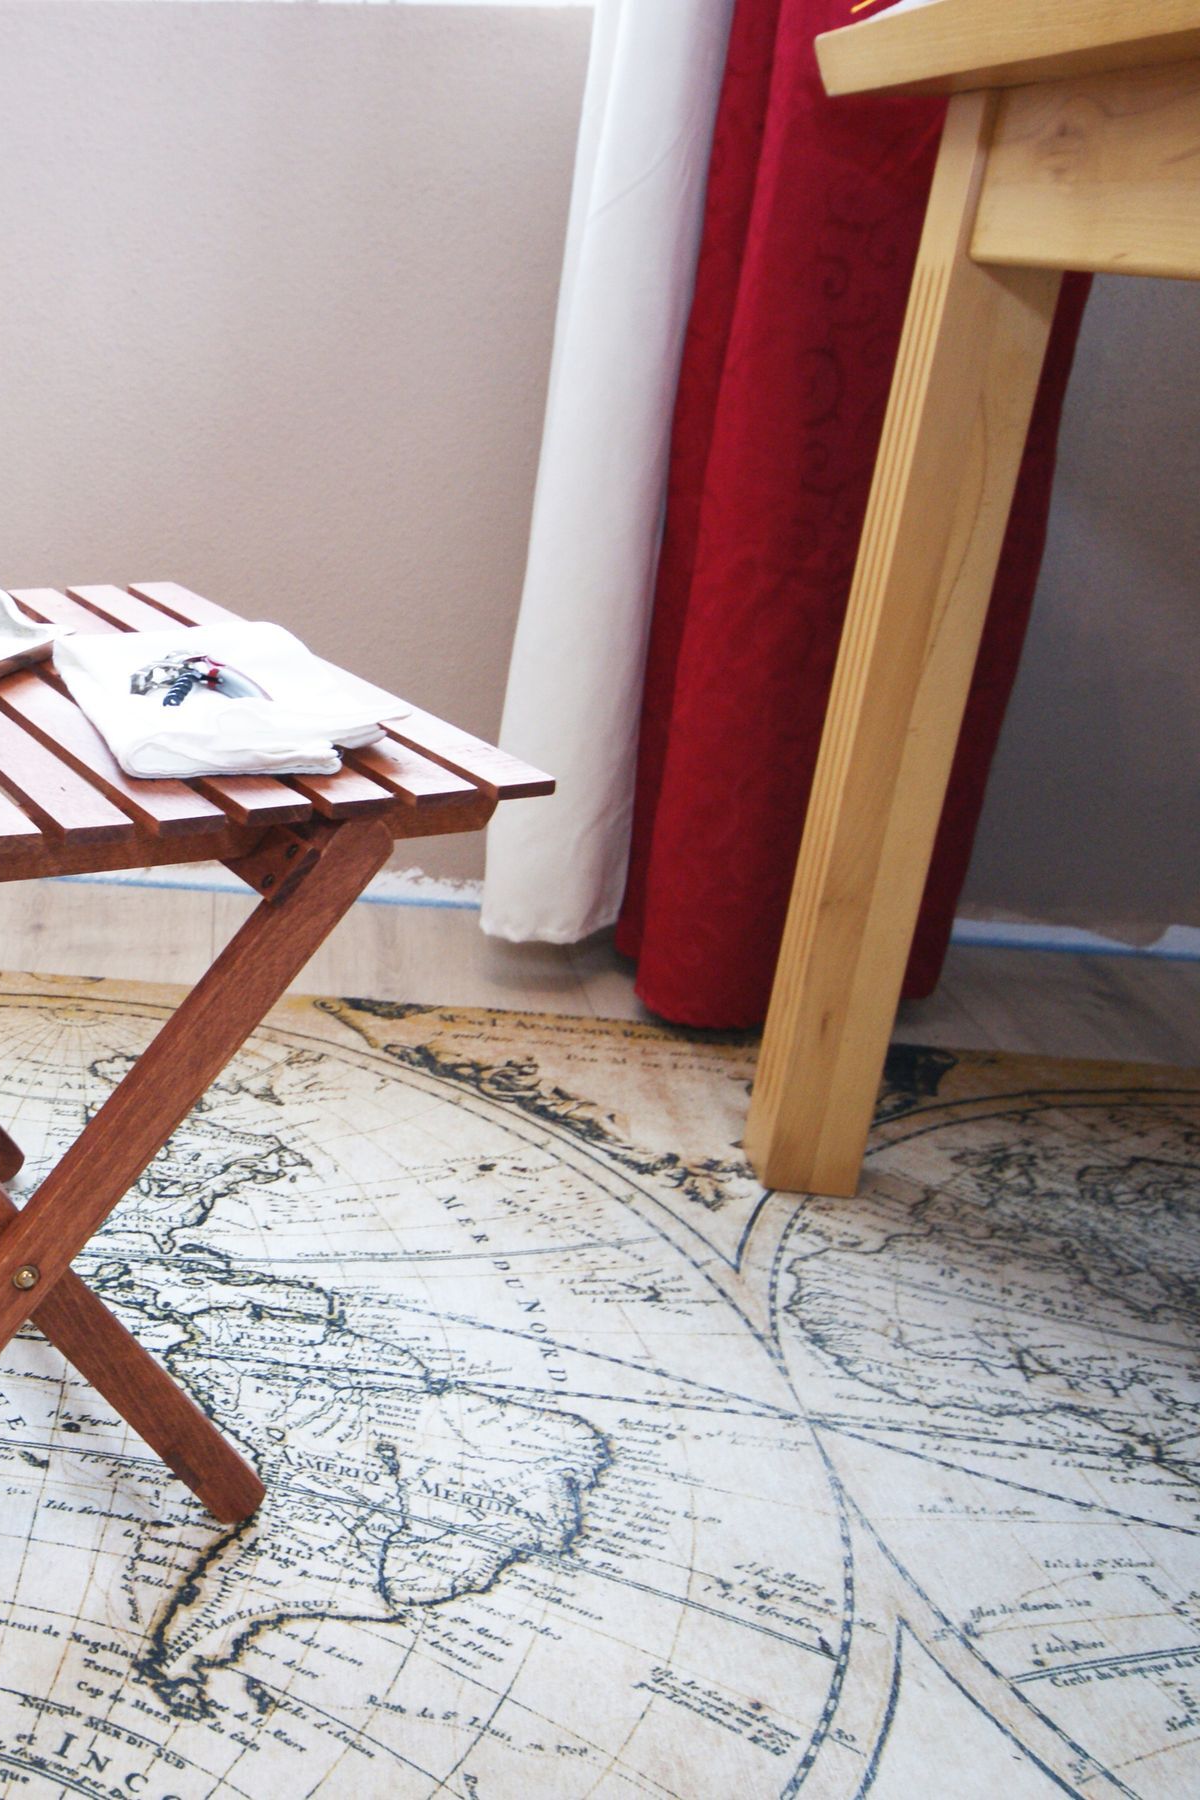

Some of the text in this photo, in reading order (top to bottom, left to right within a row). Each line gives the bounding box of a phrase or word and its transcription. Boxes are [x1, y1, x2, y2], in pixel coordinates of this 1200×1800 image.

[42, 1624, 61, 1638] de
[67, 1630, 138, 1658] Magellan
[76, 1680, 104, 1699] Cap
[109, 1688, 126, 1703] de
[16, 1730, 38, 1747] et
[152, 1747, 186, 1770] SUD
